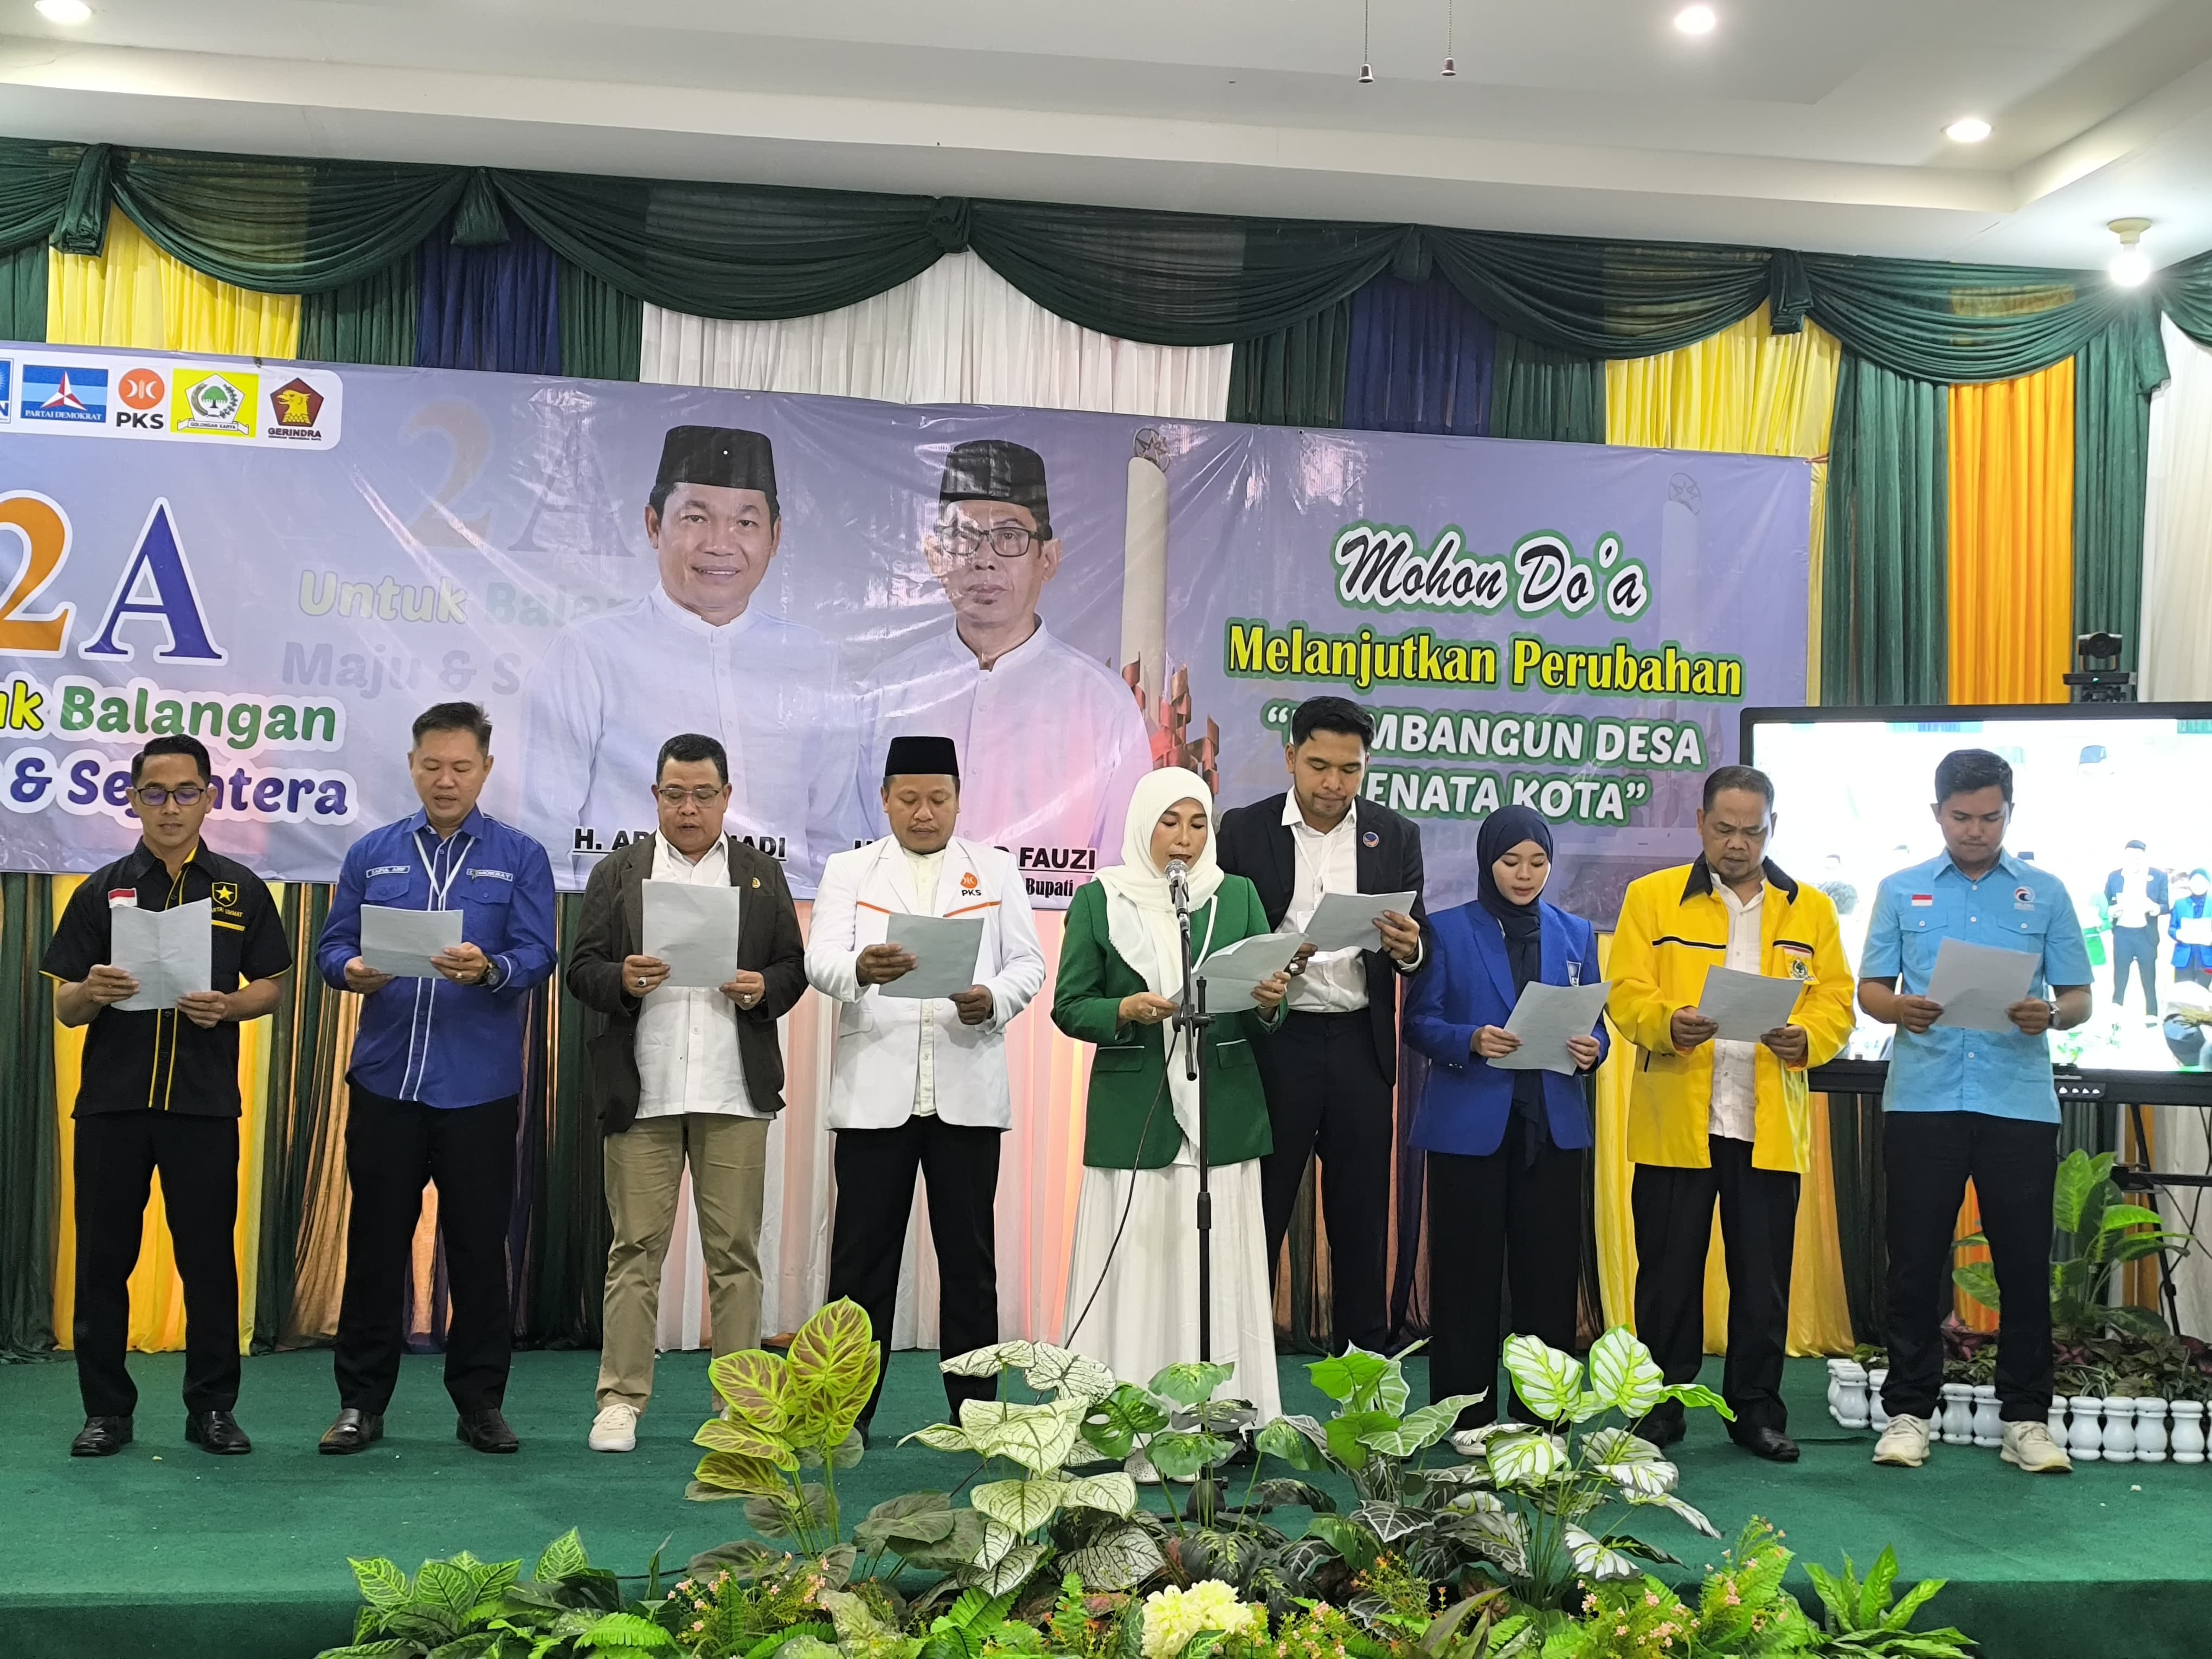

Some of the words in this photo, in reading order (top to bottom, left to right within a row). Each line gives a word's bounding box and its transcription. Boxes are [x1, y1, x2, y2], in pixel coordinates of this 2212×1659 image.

[25, 410, 54, 418] PARTAI
[55, 412, 102, 421] DEMOKRAT
[116, 411, 164, 429] PKS
[268, 427, 321, 438] GERINDRA
[1341, 530, 1504, 601] Mohon
[299, 570, 467, 623] Untuk
[281, 641, 420, 699] Maju
[437, 650, 477, 693] &
[1230, 624, 1495, 688] Melanjutkan
[1514, 639, 1741, 697] Perubahan
[60, 685, 336, 749] Balangan
[1596, 723, 1701, 765] DESA
[10, 757, 53, 802] &
[1366, 773, 1496, 812] ENATA
[575, 828, 602, 850] H.
[1019, 847, 1095, 870] FAUZI
[1026, 878, 1073, 898] Bupati
